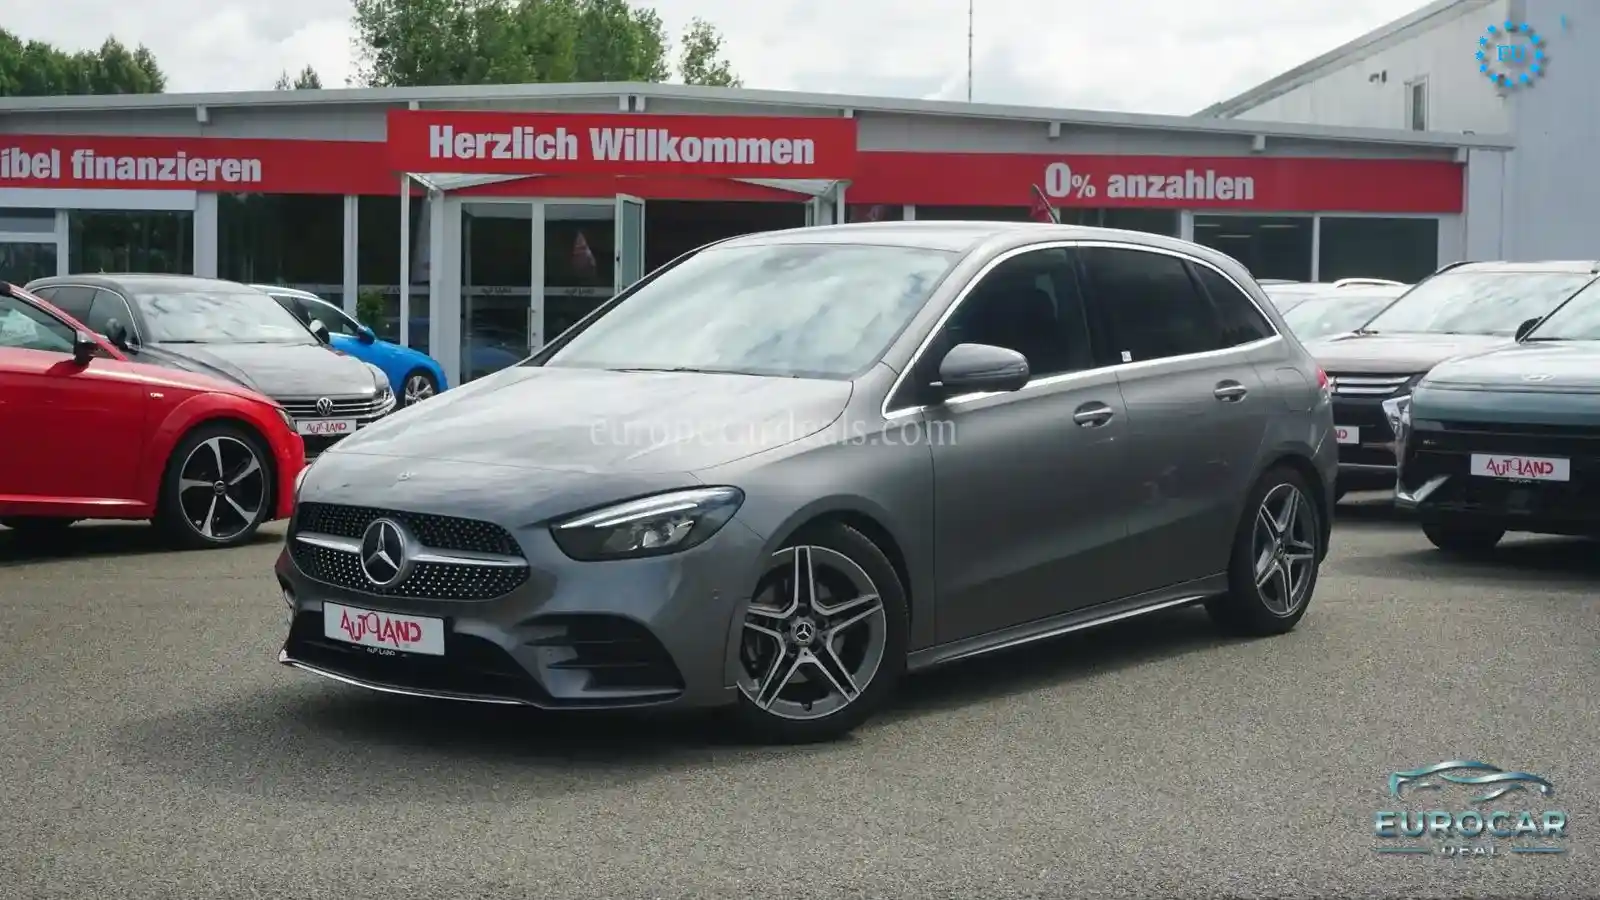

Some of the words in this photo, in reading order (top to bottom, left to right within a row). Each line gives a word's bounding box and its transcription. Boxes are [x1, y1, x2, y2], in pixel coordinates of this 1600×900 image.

[428, 124, 578, 160] Herzlich
[589, 127, 815, 165] Willkommen
[0, 147, 60, 180] ibel
[71, 149, 262, 183] finanzieren
[1045, 162, 1096, 200] 0%
[1107, 168, 1254, 200] anzahlen
